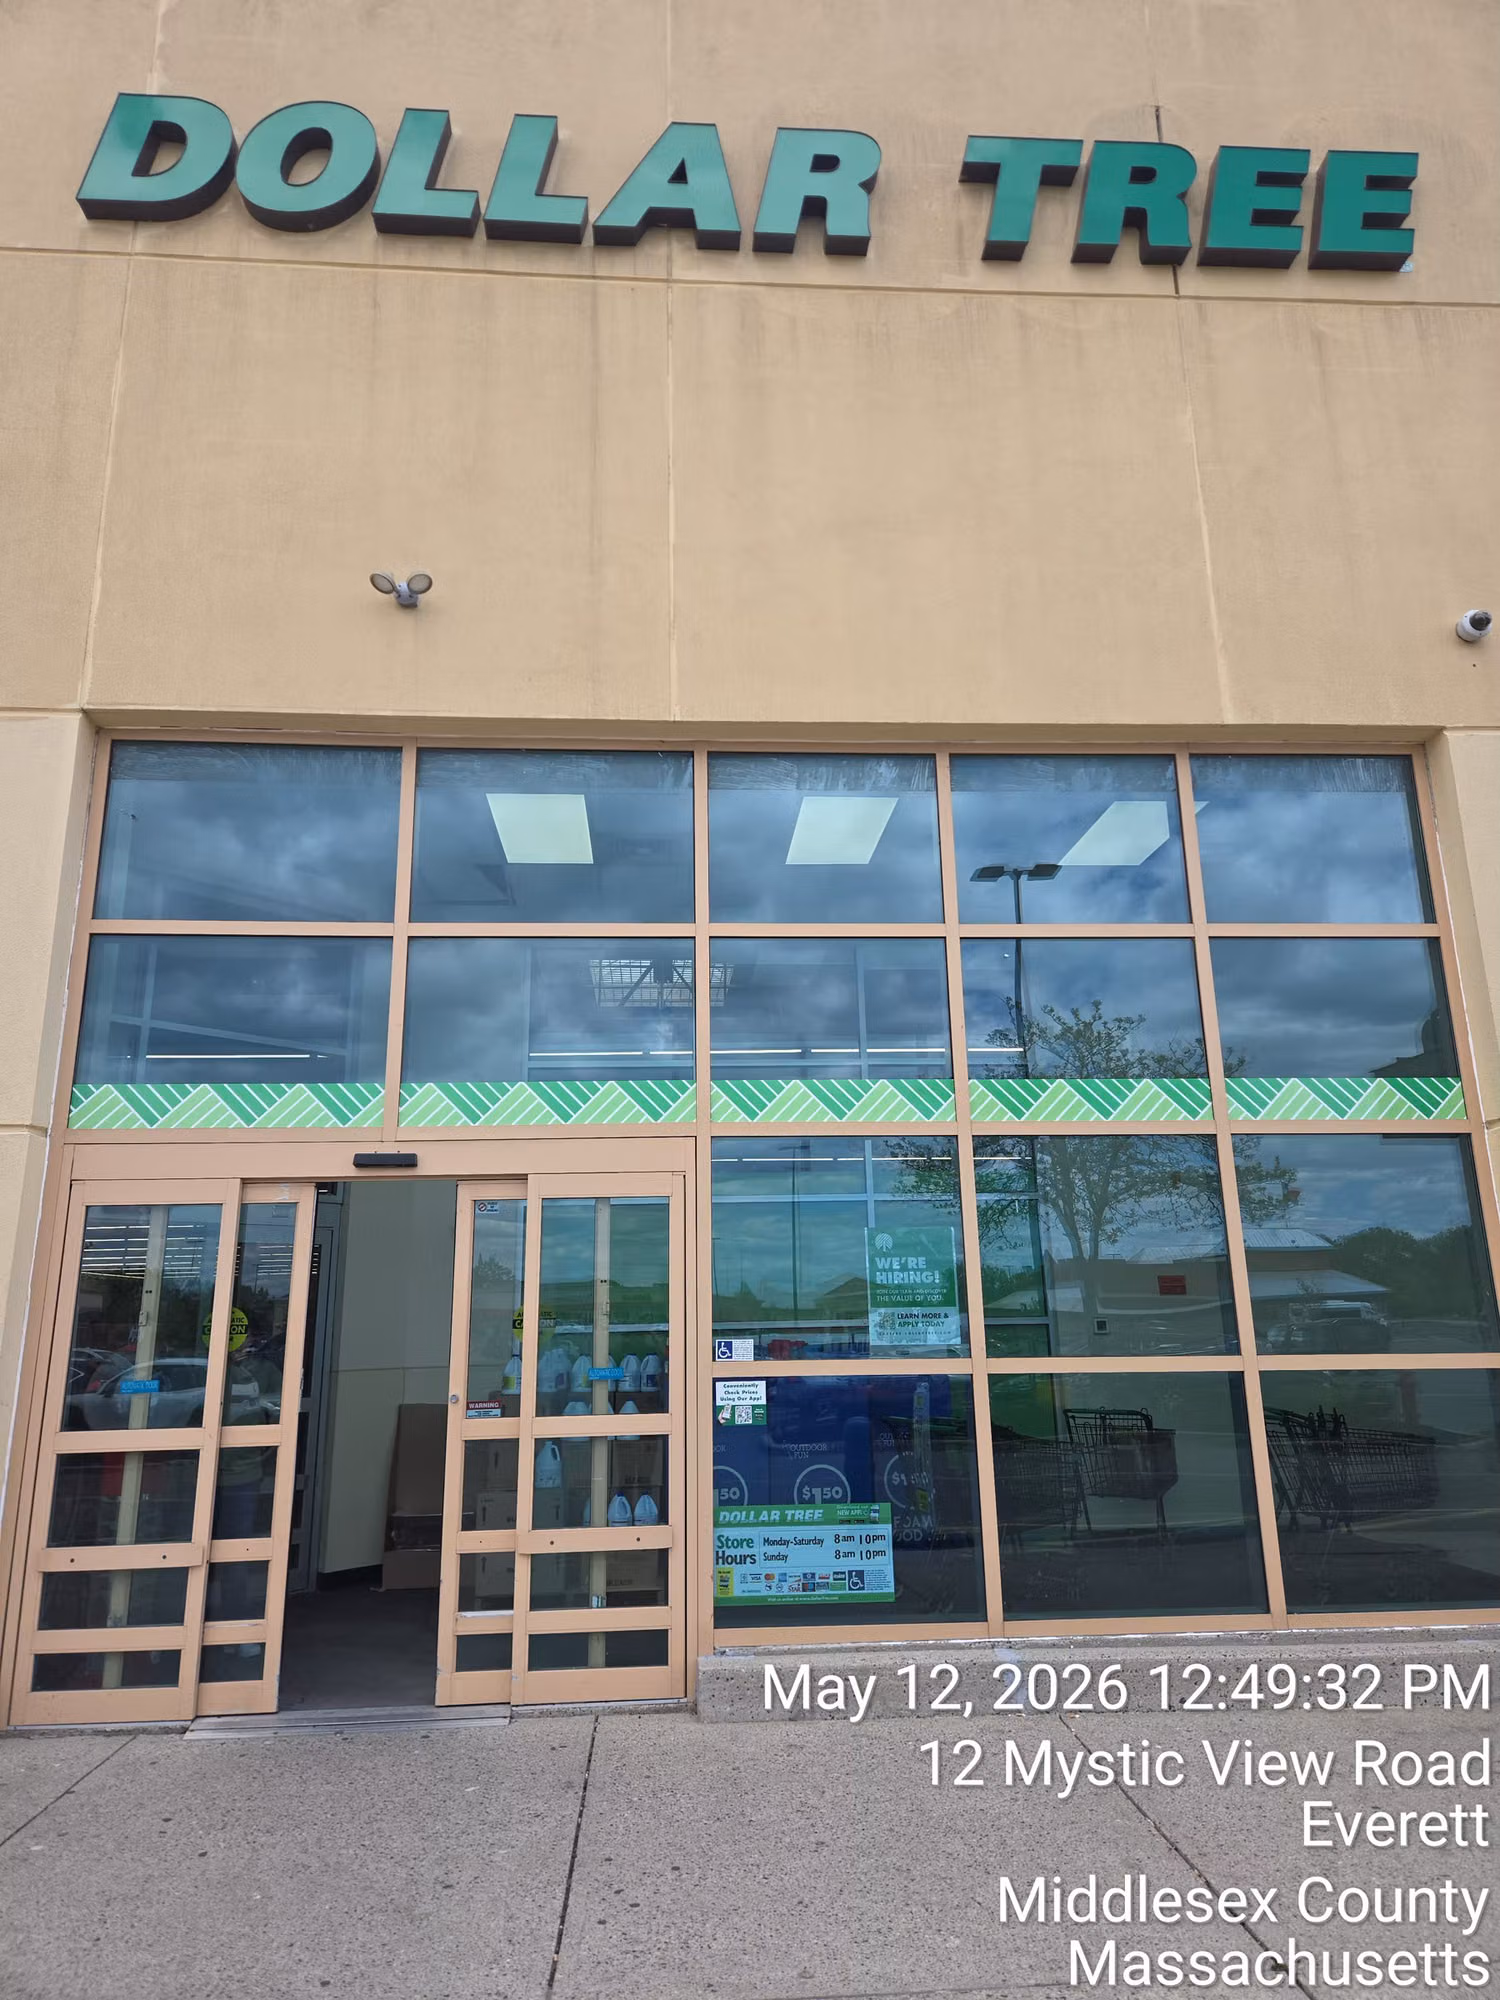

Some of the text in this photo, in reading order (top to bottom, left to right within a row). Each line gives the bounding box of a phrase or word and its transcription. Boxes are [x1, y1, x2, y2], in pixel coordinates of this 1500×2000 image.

[76, 92, 1420, 271] DOLLAR TREE
[875, 1257, 926, 1269] WE'RE
[876, 1271, 940, 1284] HIRING!
[719, 1509, 824, 1524] DOLLAR TREE
[716, 1534, 754, 1550] Store
[763, 1536, 825, 1549] Monday-Saturday
[715, 1550, 757, 1566] Hours
[763, 1551, 789, 1563] Sunday
